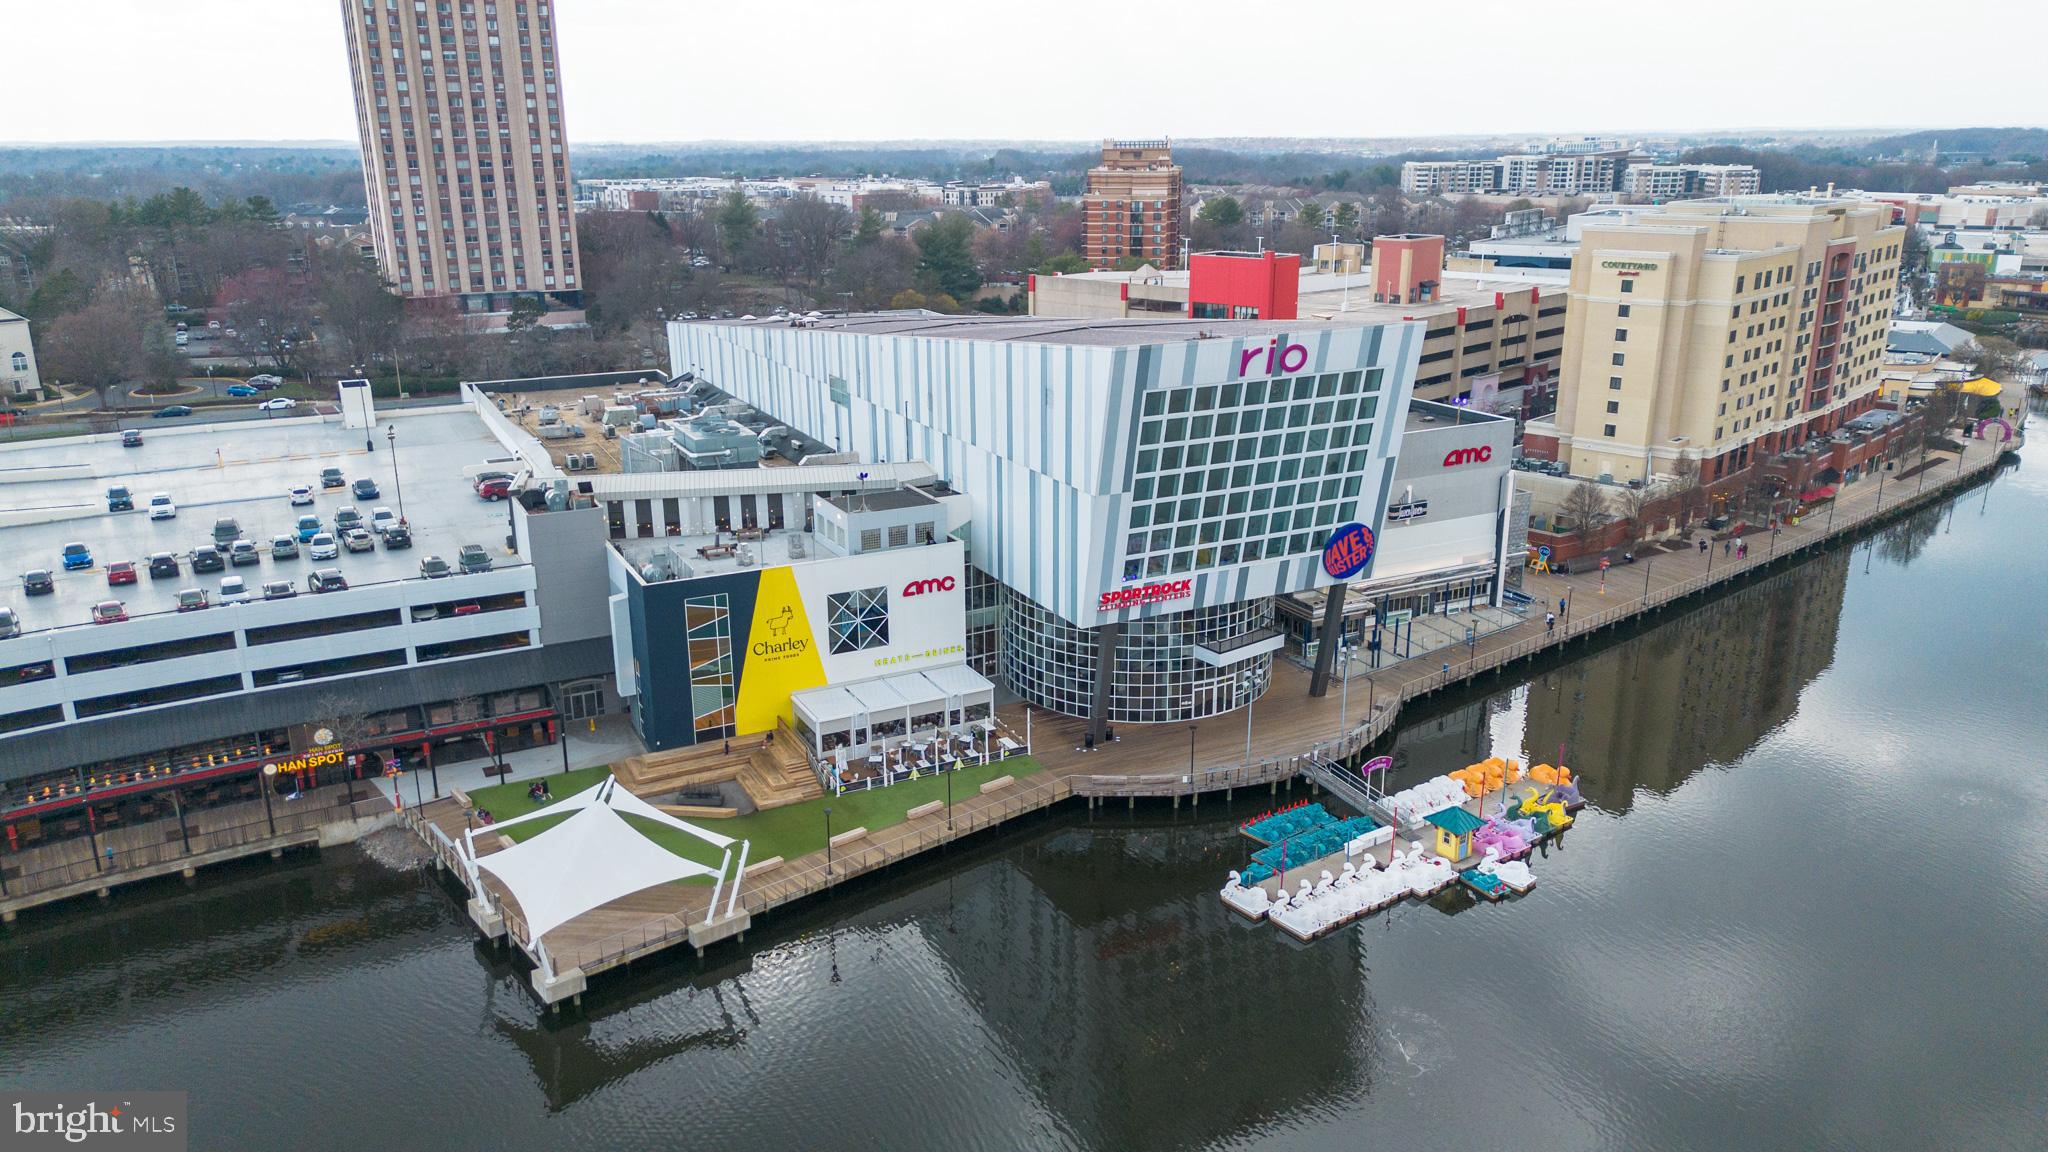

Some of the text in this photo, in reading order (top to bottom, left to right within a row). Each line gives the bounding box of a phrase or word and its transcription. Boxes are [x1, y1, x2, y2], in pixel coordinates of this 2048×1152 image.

[1601, 261, 1658, 271] COURTYARD
[1239, 338, 1308, 377] rio
[1325, 530, 1363, 567] DAVE
[1100, 579, 1192, 605] SPORTROCK
[753, 637, 808, 656] Charley
[277, 759, 306, 774] HAN
[308, 752, 345, 767] SPOT
